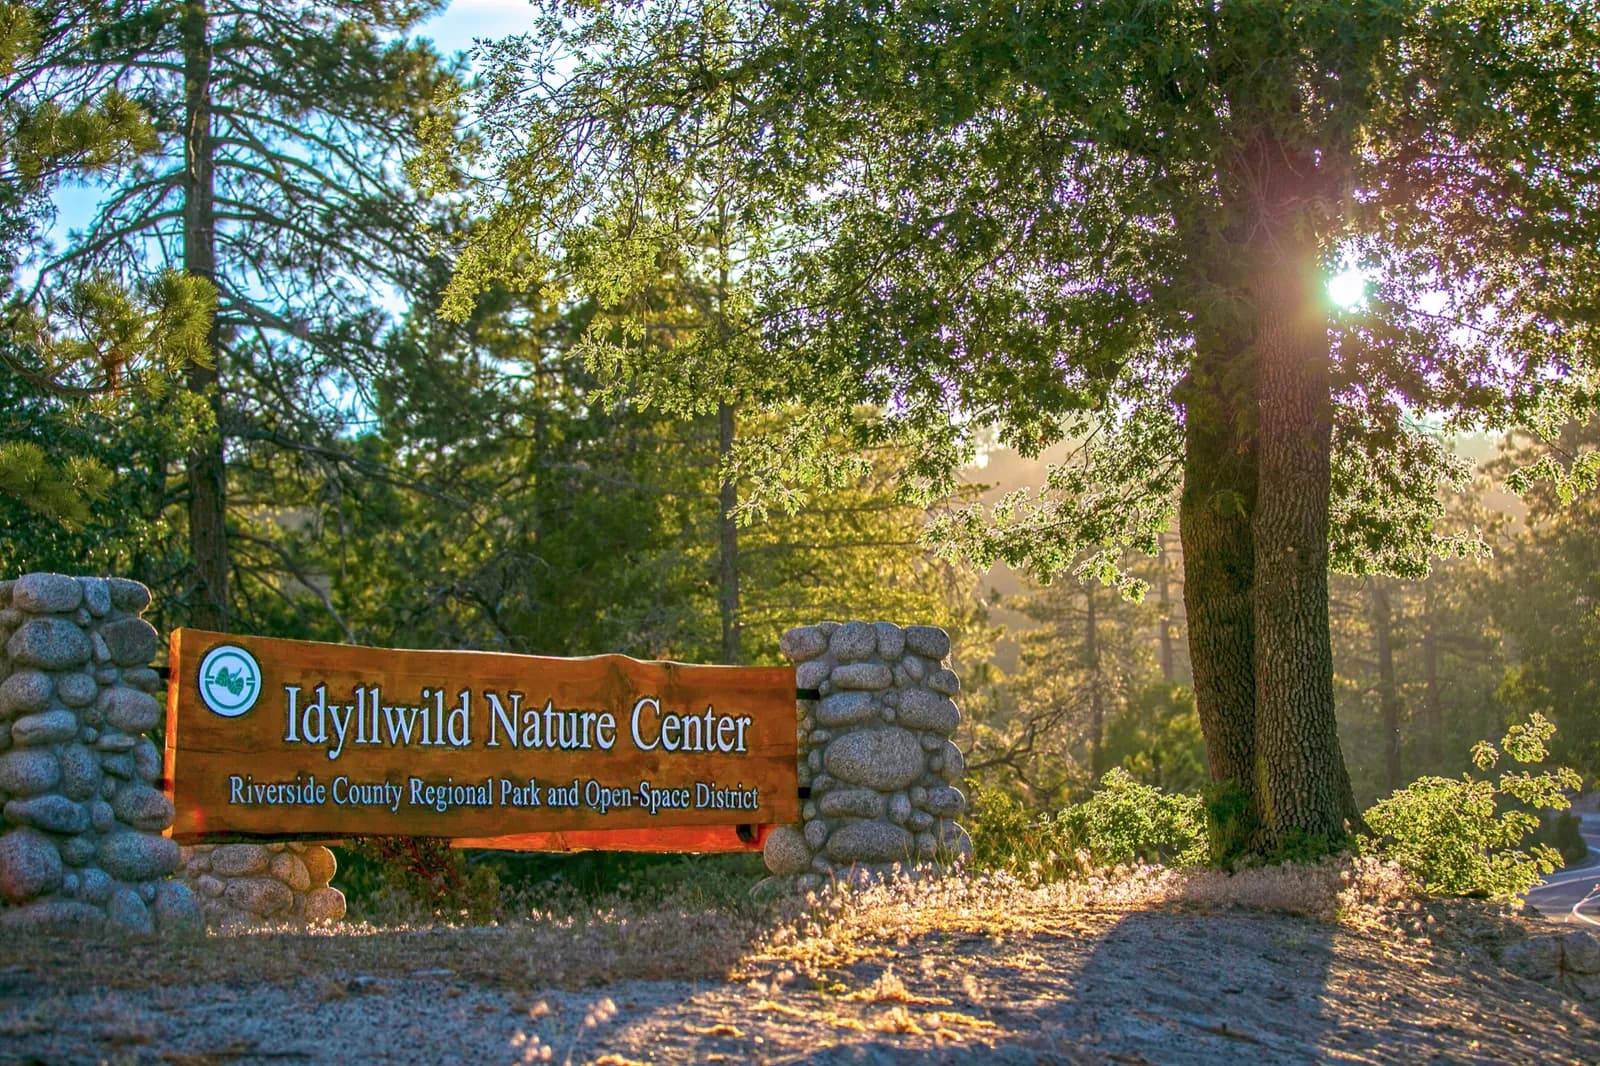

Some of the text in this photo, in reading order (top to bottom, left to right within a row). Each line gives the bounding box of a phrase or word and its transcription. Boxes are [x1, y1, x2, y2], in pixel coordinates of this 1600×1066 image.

[284, 686, 751, 760] Idyllwild Nature Center
[230, 776, 759, 814] Riverside County Regional Park and Open-Space District
